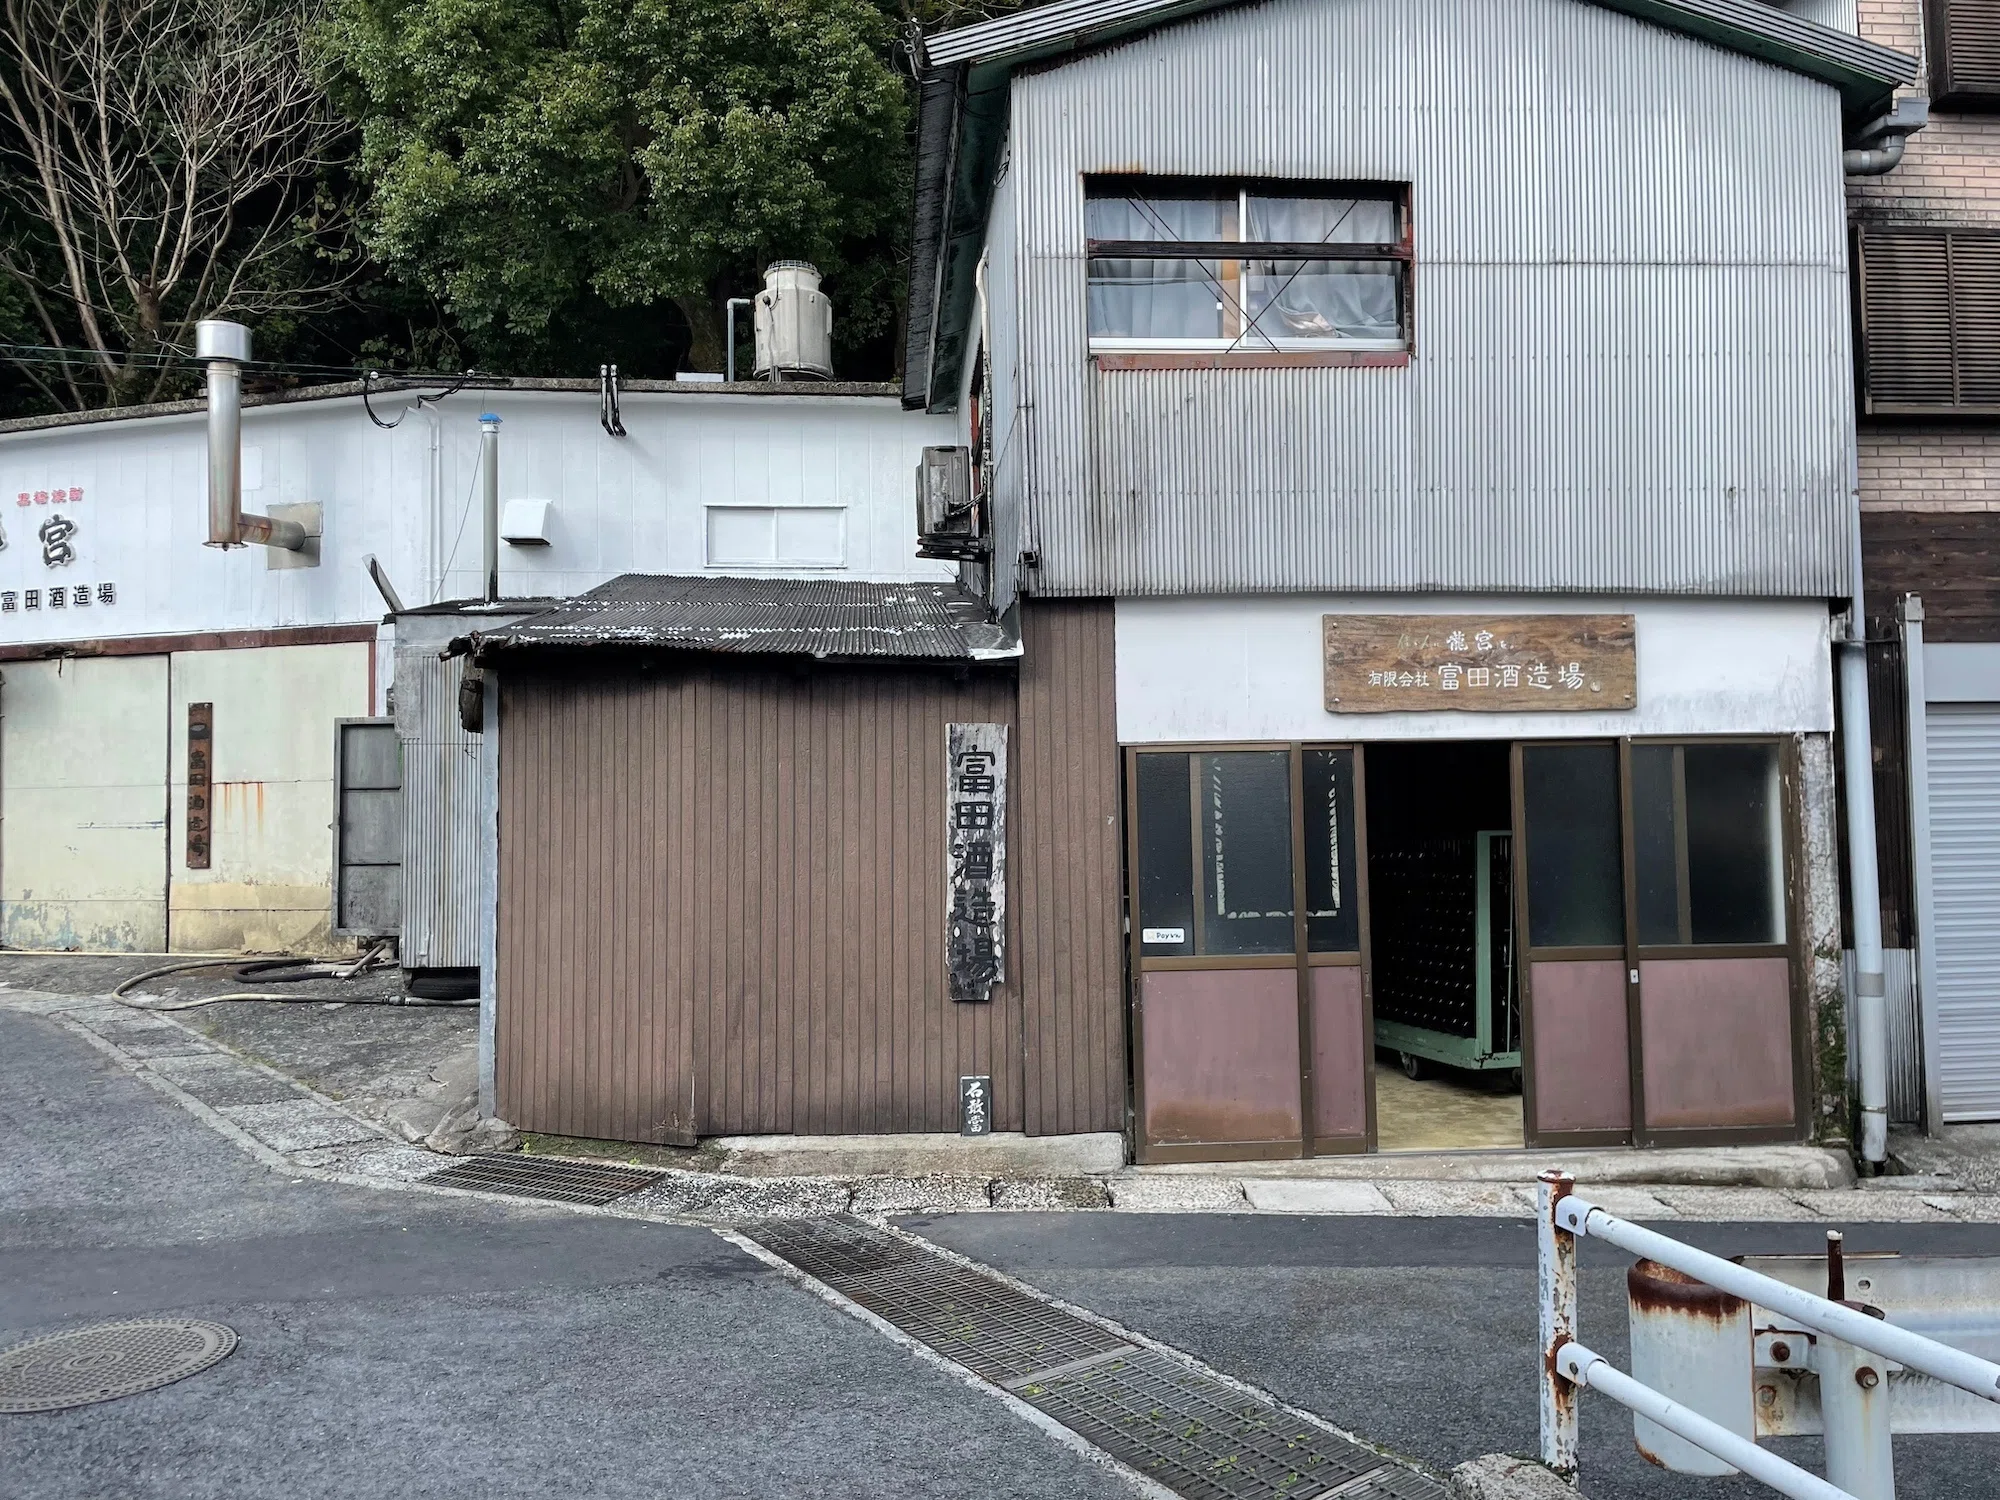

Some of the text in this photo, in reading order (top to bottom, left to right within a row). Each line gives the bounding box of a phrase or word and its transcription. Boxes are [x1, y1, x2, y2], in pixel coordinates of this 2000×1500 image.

[0, 582, 116, 612] 富田酒造場
[1368, 662, 1586, 691] 有限会社 富田酒造場
[951, 744, 998, 984] 富田酒造場
